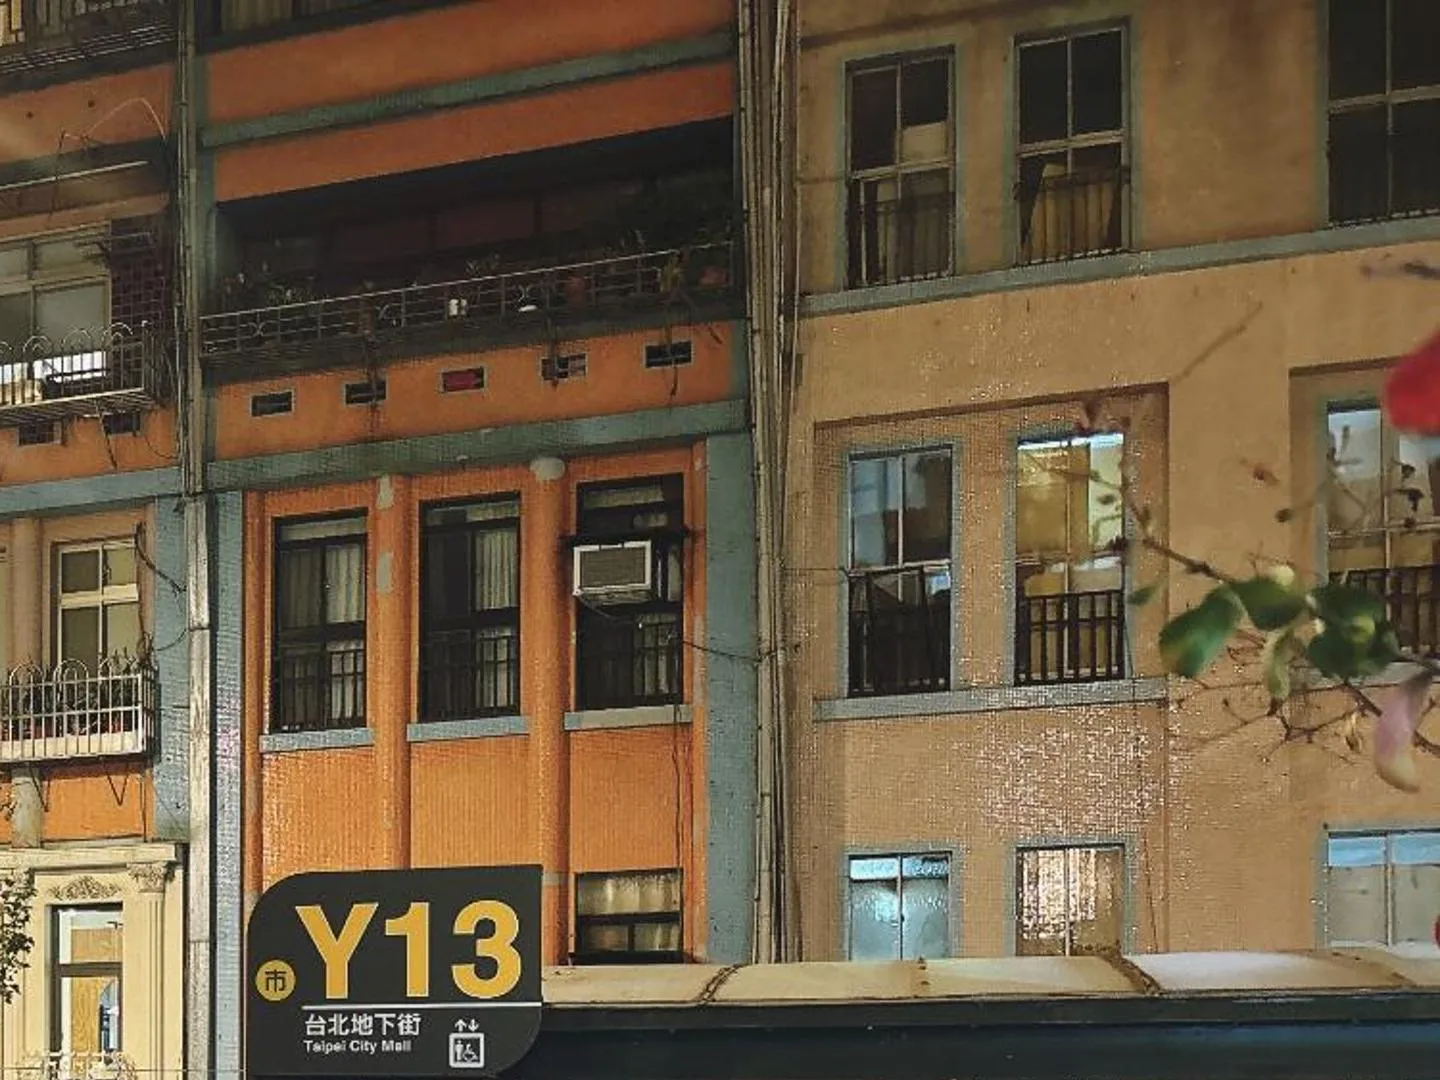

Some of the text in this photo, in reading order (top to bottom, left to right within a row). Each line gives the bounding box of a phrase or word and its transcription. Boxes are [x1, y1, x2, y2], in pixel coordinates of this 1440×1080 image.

[295, 899, 522, 999] Y13
[264, 968, 287, 993] 市
[304, 1013, 422, 1036] 台北地下街
[303, 1040, 412, 1055] Taipei City Mall
